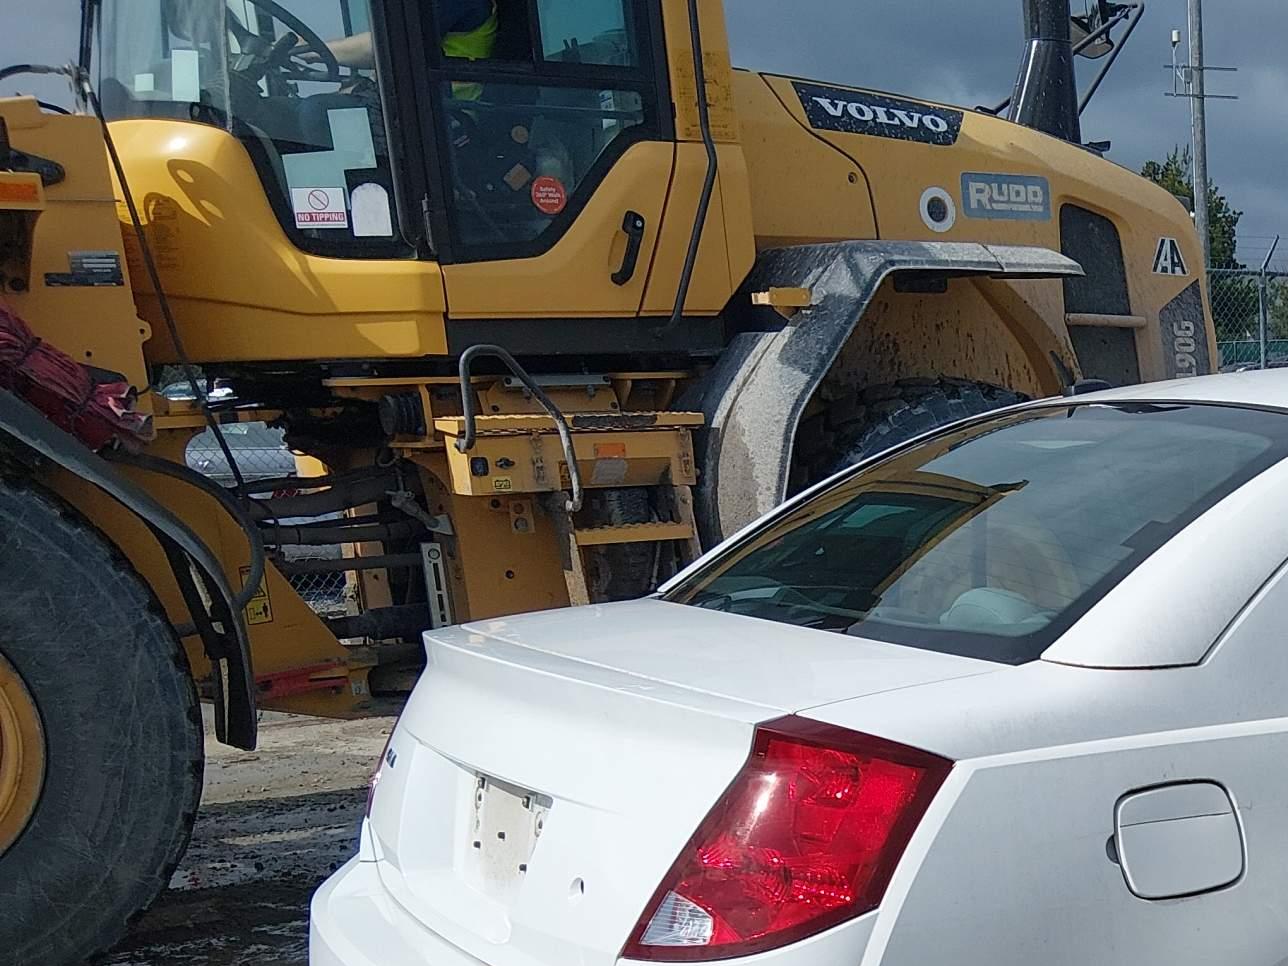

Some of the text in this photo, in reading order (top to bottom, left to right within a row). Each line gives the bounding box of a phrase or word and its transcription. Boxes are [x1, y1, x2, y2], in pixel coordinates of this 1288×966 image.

[811, 96, 948, 132] VOLVO
[297, 212, 344, 222] NO TIPPING
